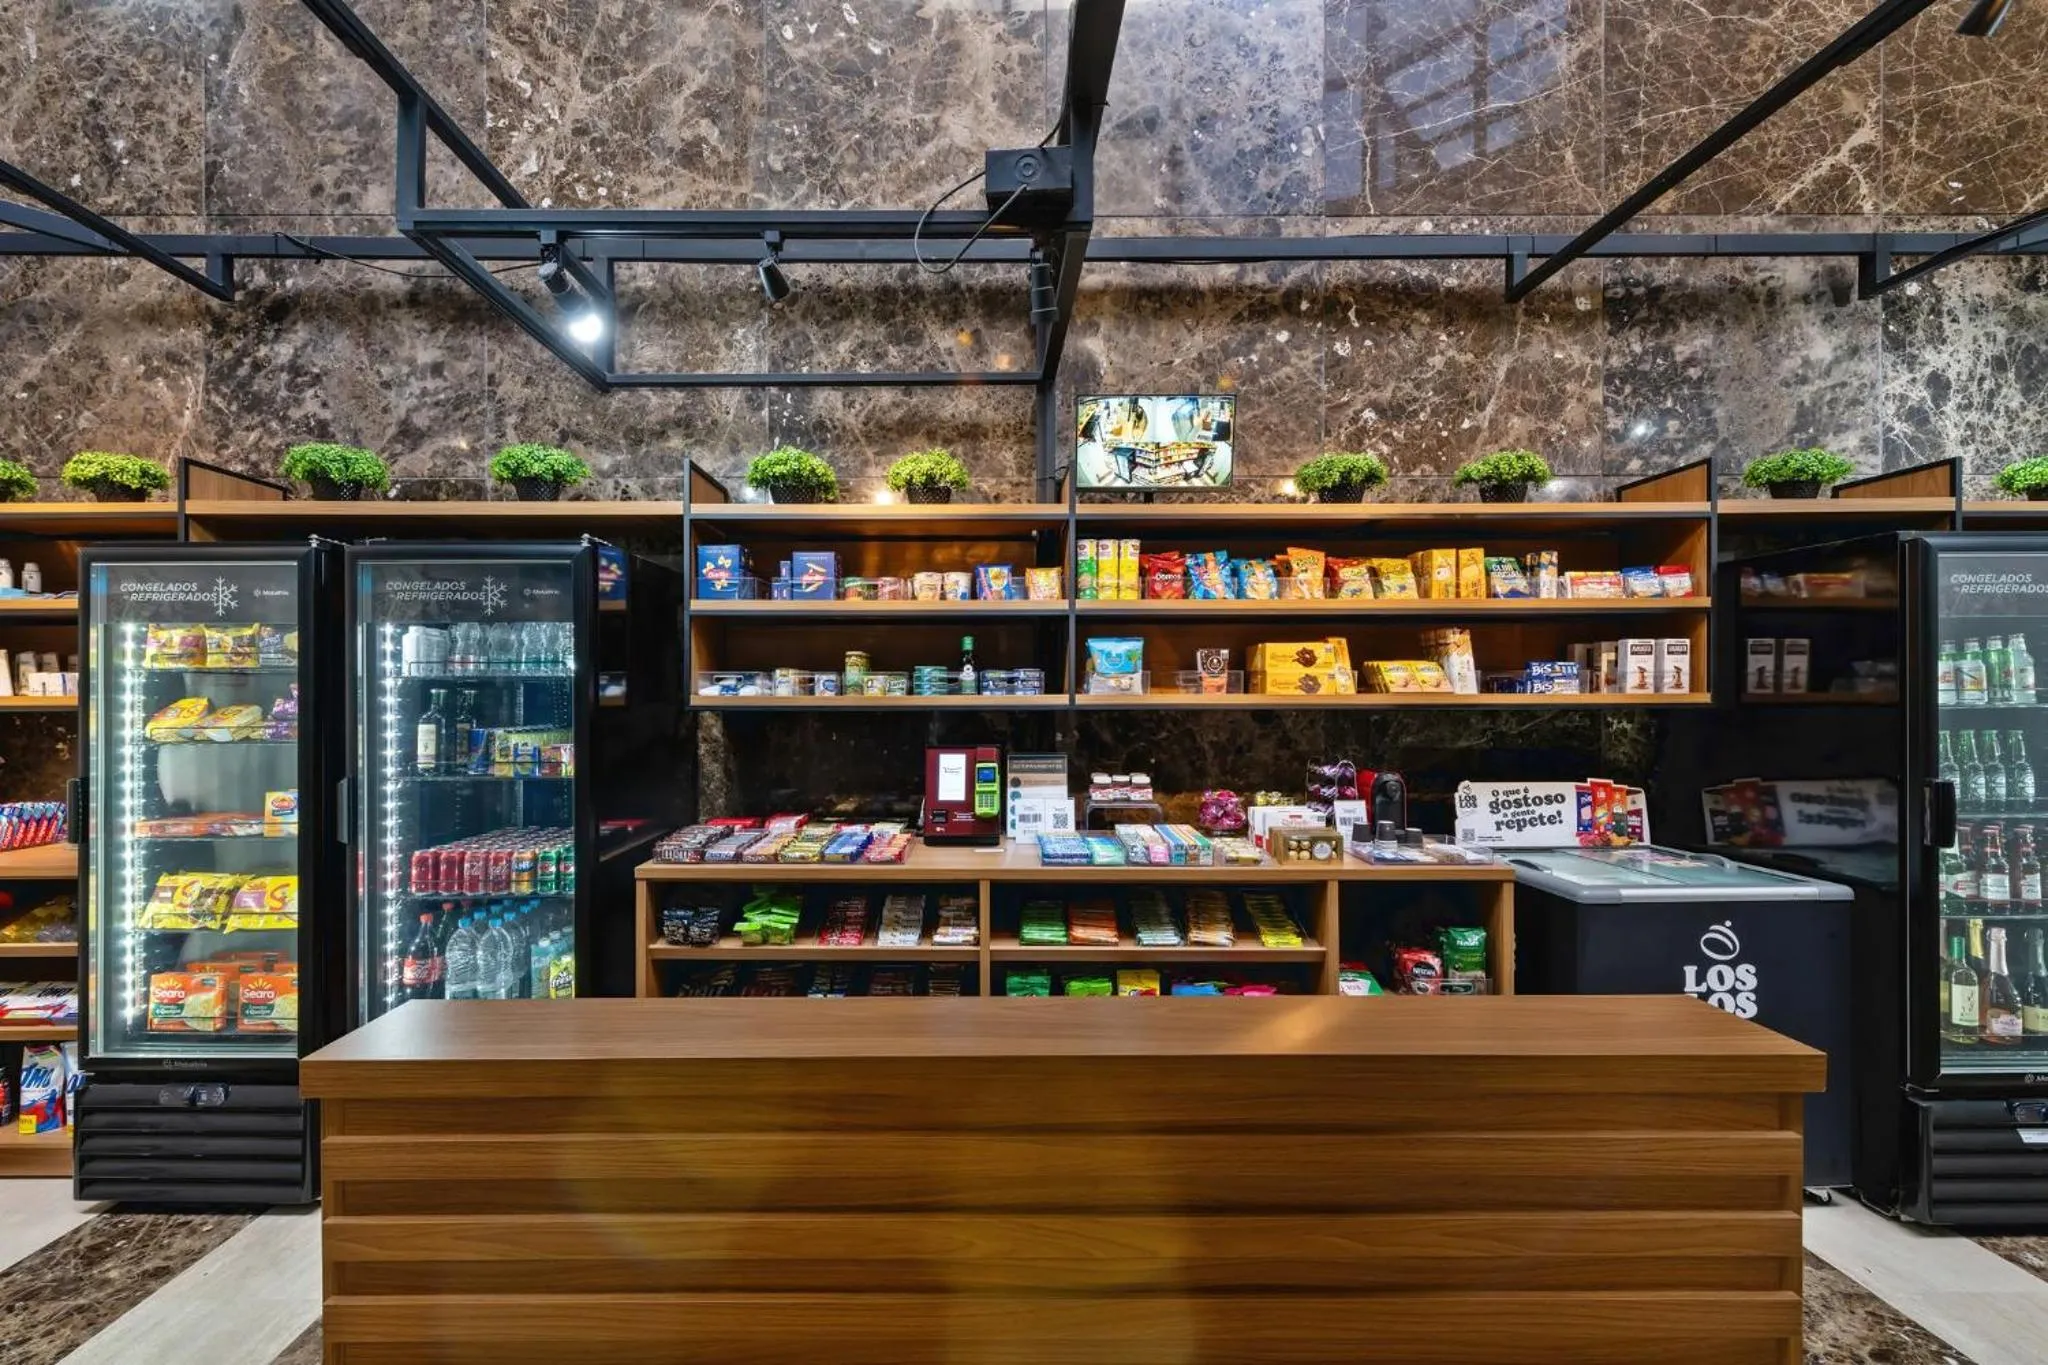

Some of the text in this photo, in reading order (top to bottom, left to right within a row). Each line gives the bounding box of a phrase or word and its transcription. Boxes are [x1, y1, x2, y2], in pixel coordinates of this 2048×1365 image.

[1949, 573, 2032, 583] CONGELADOS
[119, 582, 198, 592] CONGELADOS
[385, 581, 467, 591] CONGELADOS
[130, 592, 217, 602] REFRIGERADOS
[396, 591, 487, 601] REFRIGERADOS
[1502, 787, 1521, 798] que
[1488, 793, 1567, 815] gostoso
[1510, 808, 1536, 819] gente
[1494, 810, 1564, 832] repete!
[1683, 963, 1758, 992] LOS
[154, 988, 185, 999] Seara
[243, 988, 275, 999] Seara
[1685, 991, 1758, 1019] OS
